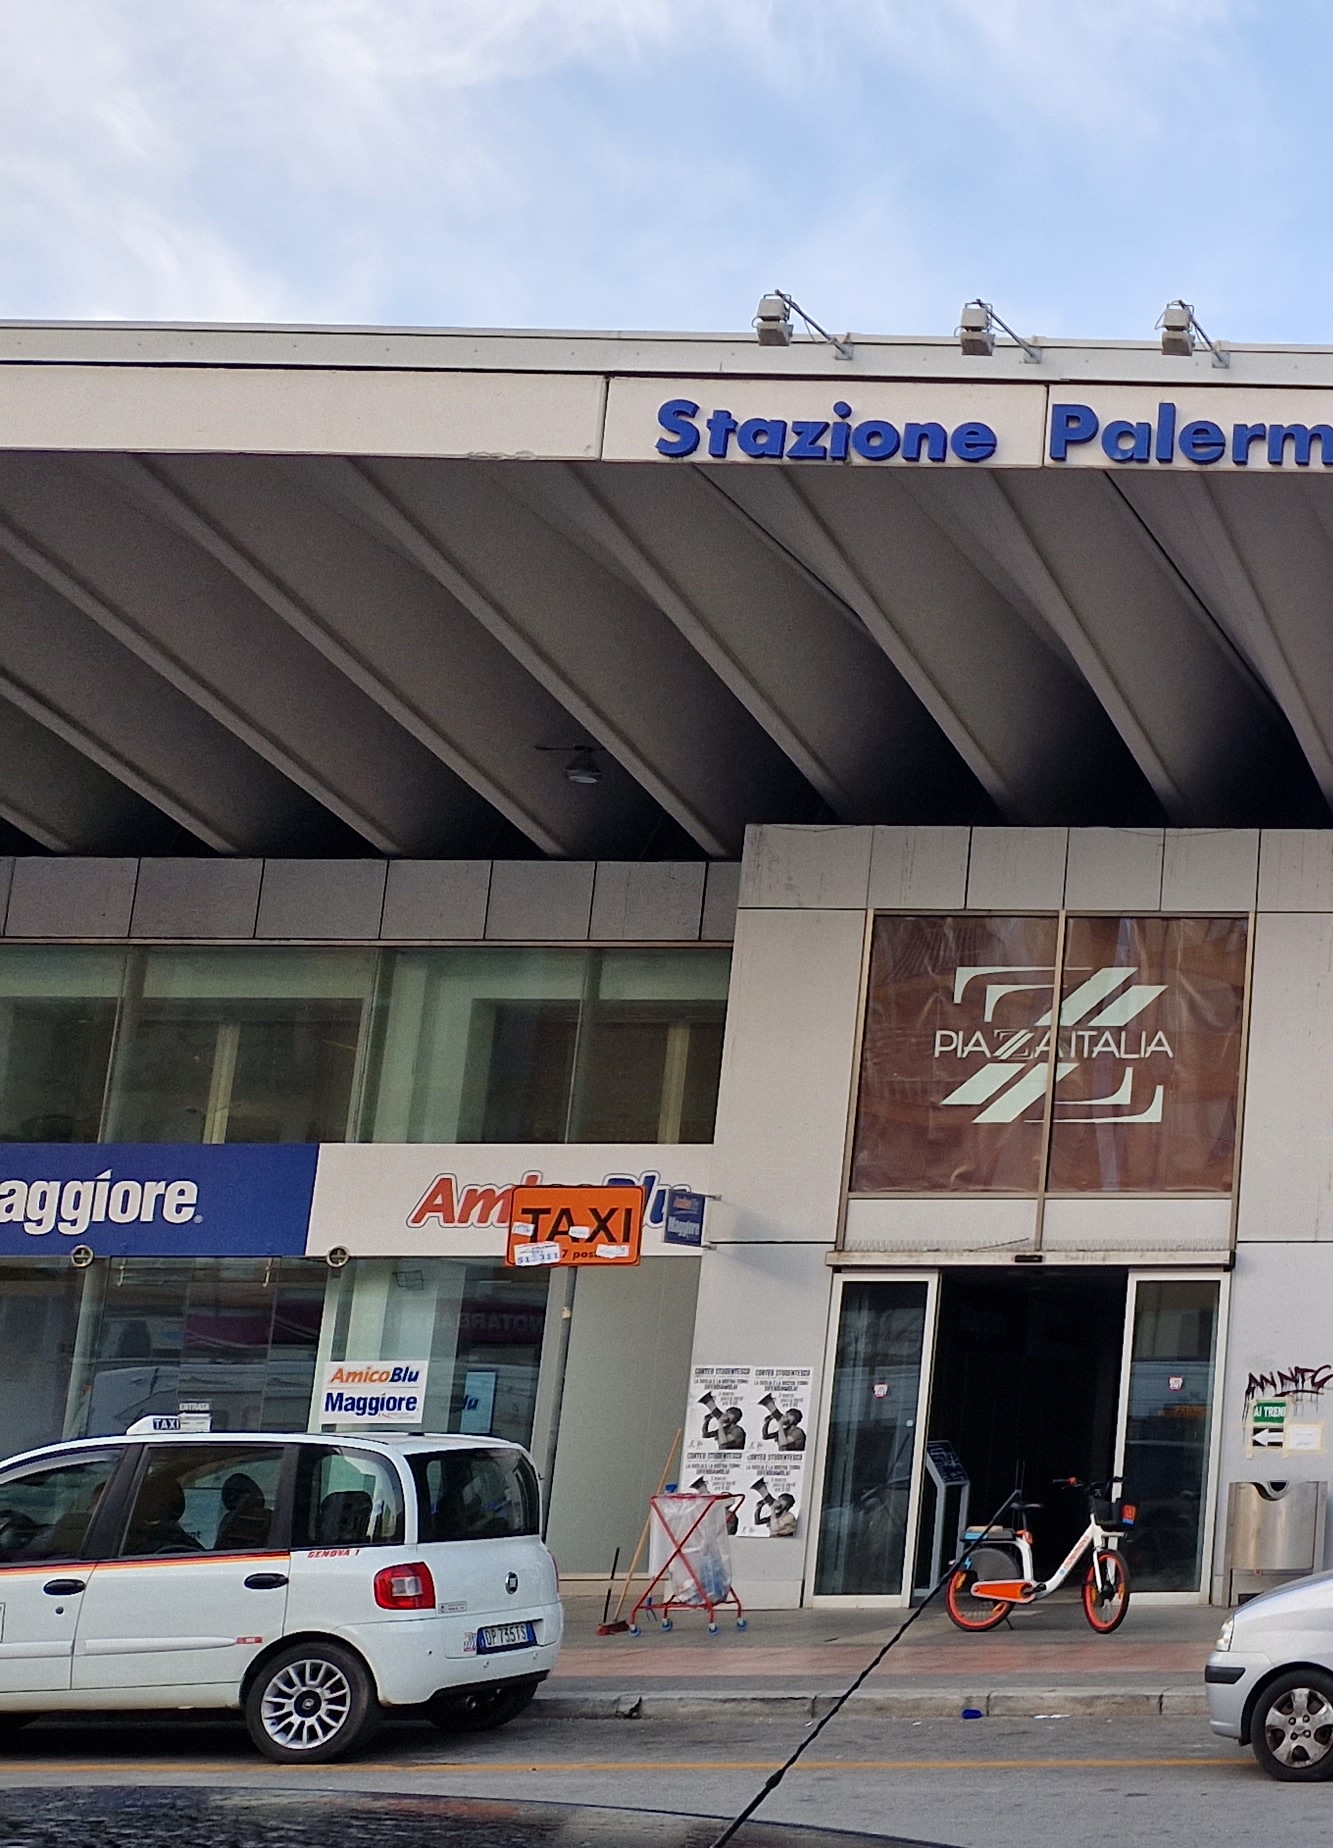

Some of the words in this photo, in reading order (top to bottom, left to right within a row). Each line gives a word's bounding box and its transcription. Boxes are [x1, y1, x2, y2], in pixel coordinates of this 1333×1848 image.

[655, 399, 998, 462] Stazione
[1070, 1030, 1173, 1059] ITALIA
[521, 1207, 633, 1243] TAXI
[330, 1366, 420, 1383] AmicoBlu
[324, 1392, 418, 1416] Maggiore
[1253, 1406, 1262, 1417] AI
[1264, 1406, 1286, 1418] TRENI
[154, 1419, 180, 1429] TAXI
